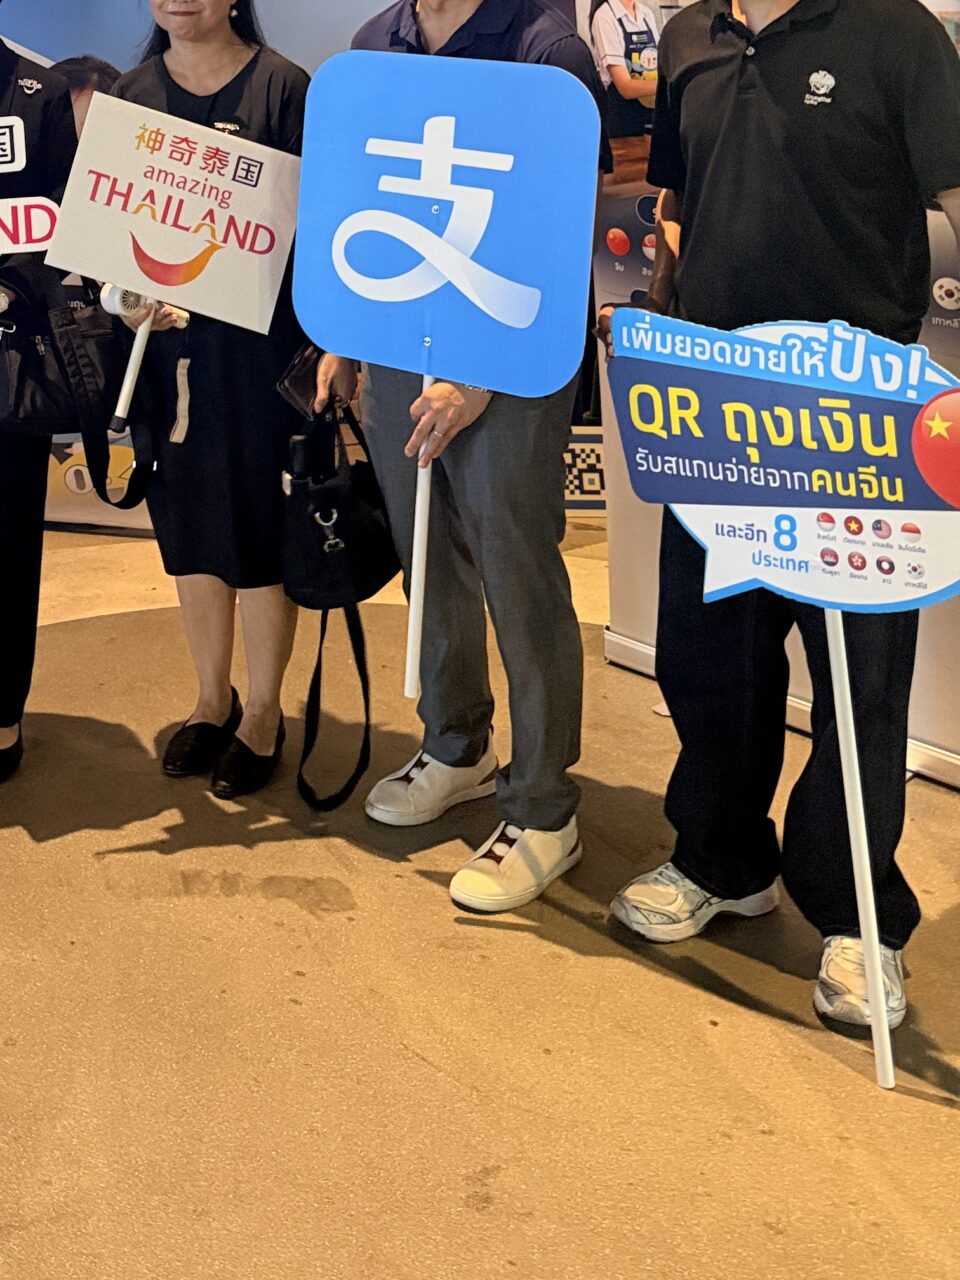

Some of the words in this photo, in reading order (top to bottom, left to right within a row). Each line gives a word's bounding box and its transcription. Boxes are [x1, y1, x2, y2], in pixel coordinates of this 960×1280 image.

[134, 122, 265, 188] 神奇泰国
[87, 169, 276, 255] THAILAND
[143, 163, 233, 209] amazing
[621, 315, 922, 400] เพิ่มยอดขายให้ปัง!
[628, 384, 704, 440] QR
[721, 398, 899, 463] ถุงเงิน
[635, 447, 904, 502] รับสแกนจ่ายจากคนจีน
[715, 521, 767, 543] และอีก
[773, 514, 797, 551] 8
[752, 549, 809, 574] ประเทศ
